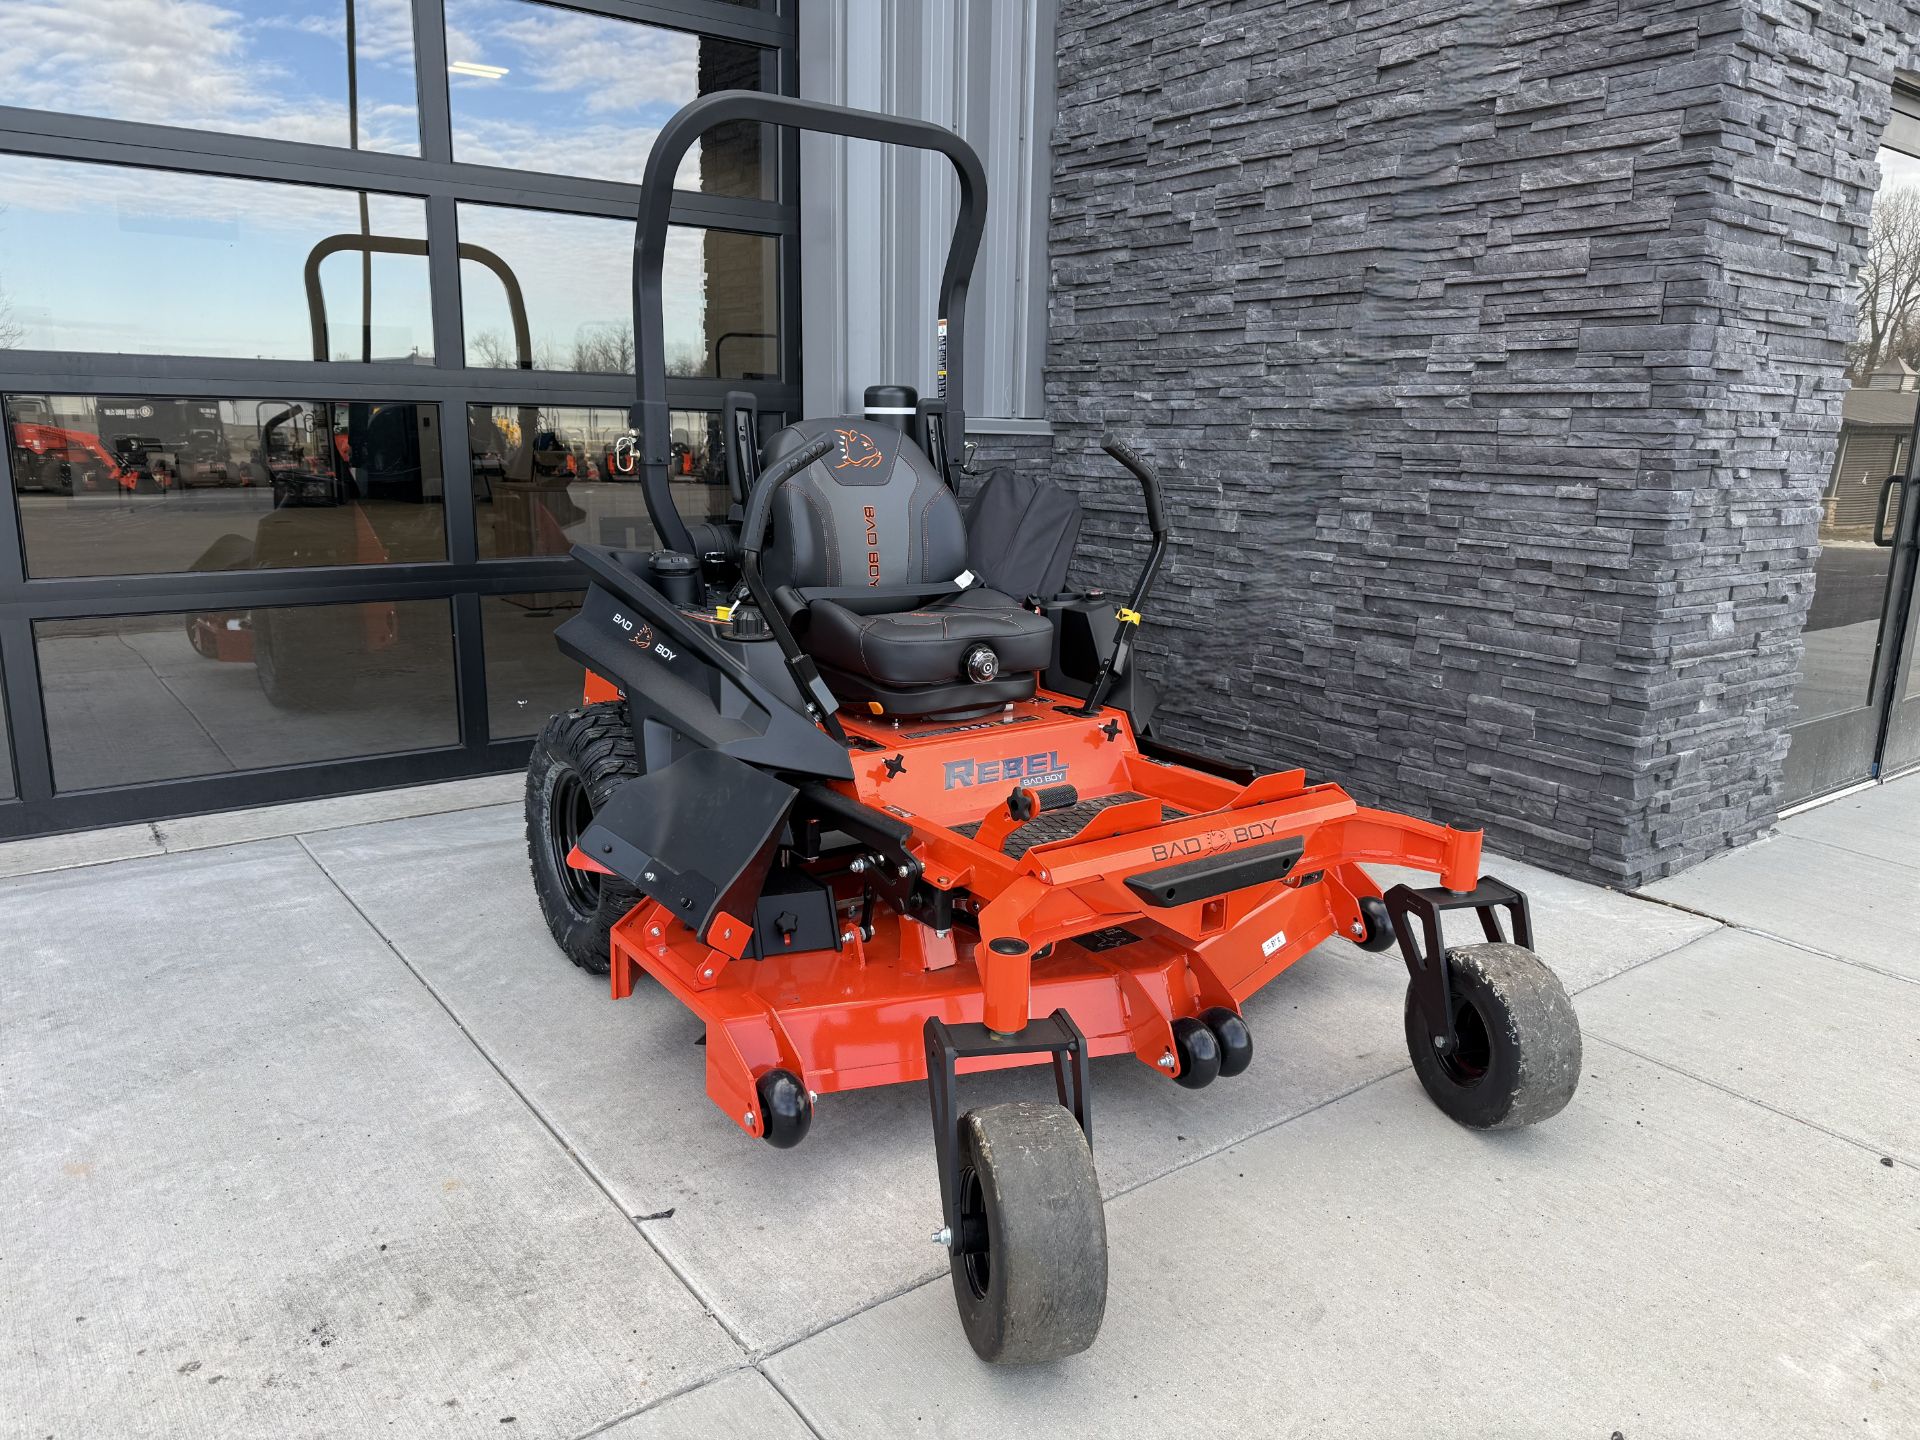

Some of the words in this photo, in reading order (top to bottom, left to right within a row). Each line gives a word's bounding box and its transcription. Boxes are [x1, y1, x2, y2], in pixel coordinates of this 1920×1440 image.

[863, 505, 878, 546] BAD
[867, 551, 880, 587] BOY
[612, 613, 633, 631] BAD
[654, 642, 677, 661] BOY
[942, 751, 1070, 791] REBEL
[1023, 776, 1043, 787] BAD
[1044, 773, 1063, 783] BOY
[1152, 838, 1202, 862] BAD
[1233, 820, 1278, 843] BOY
